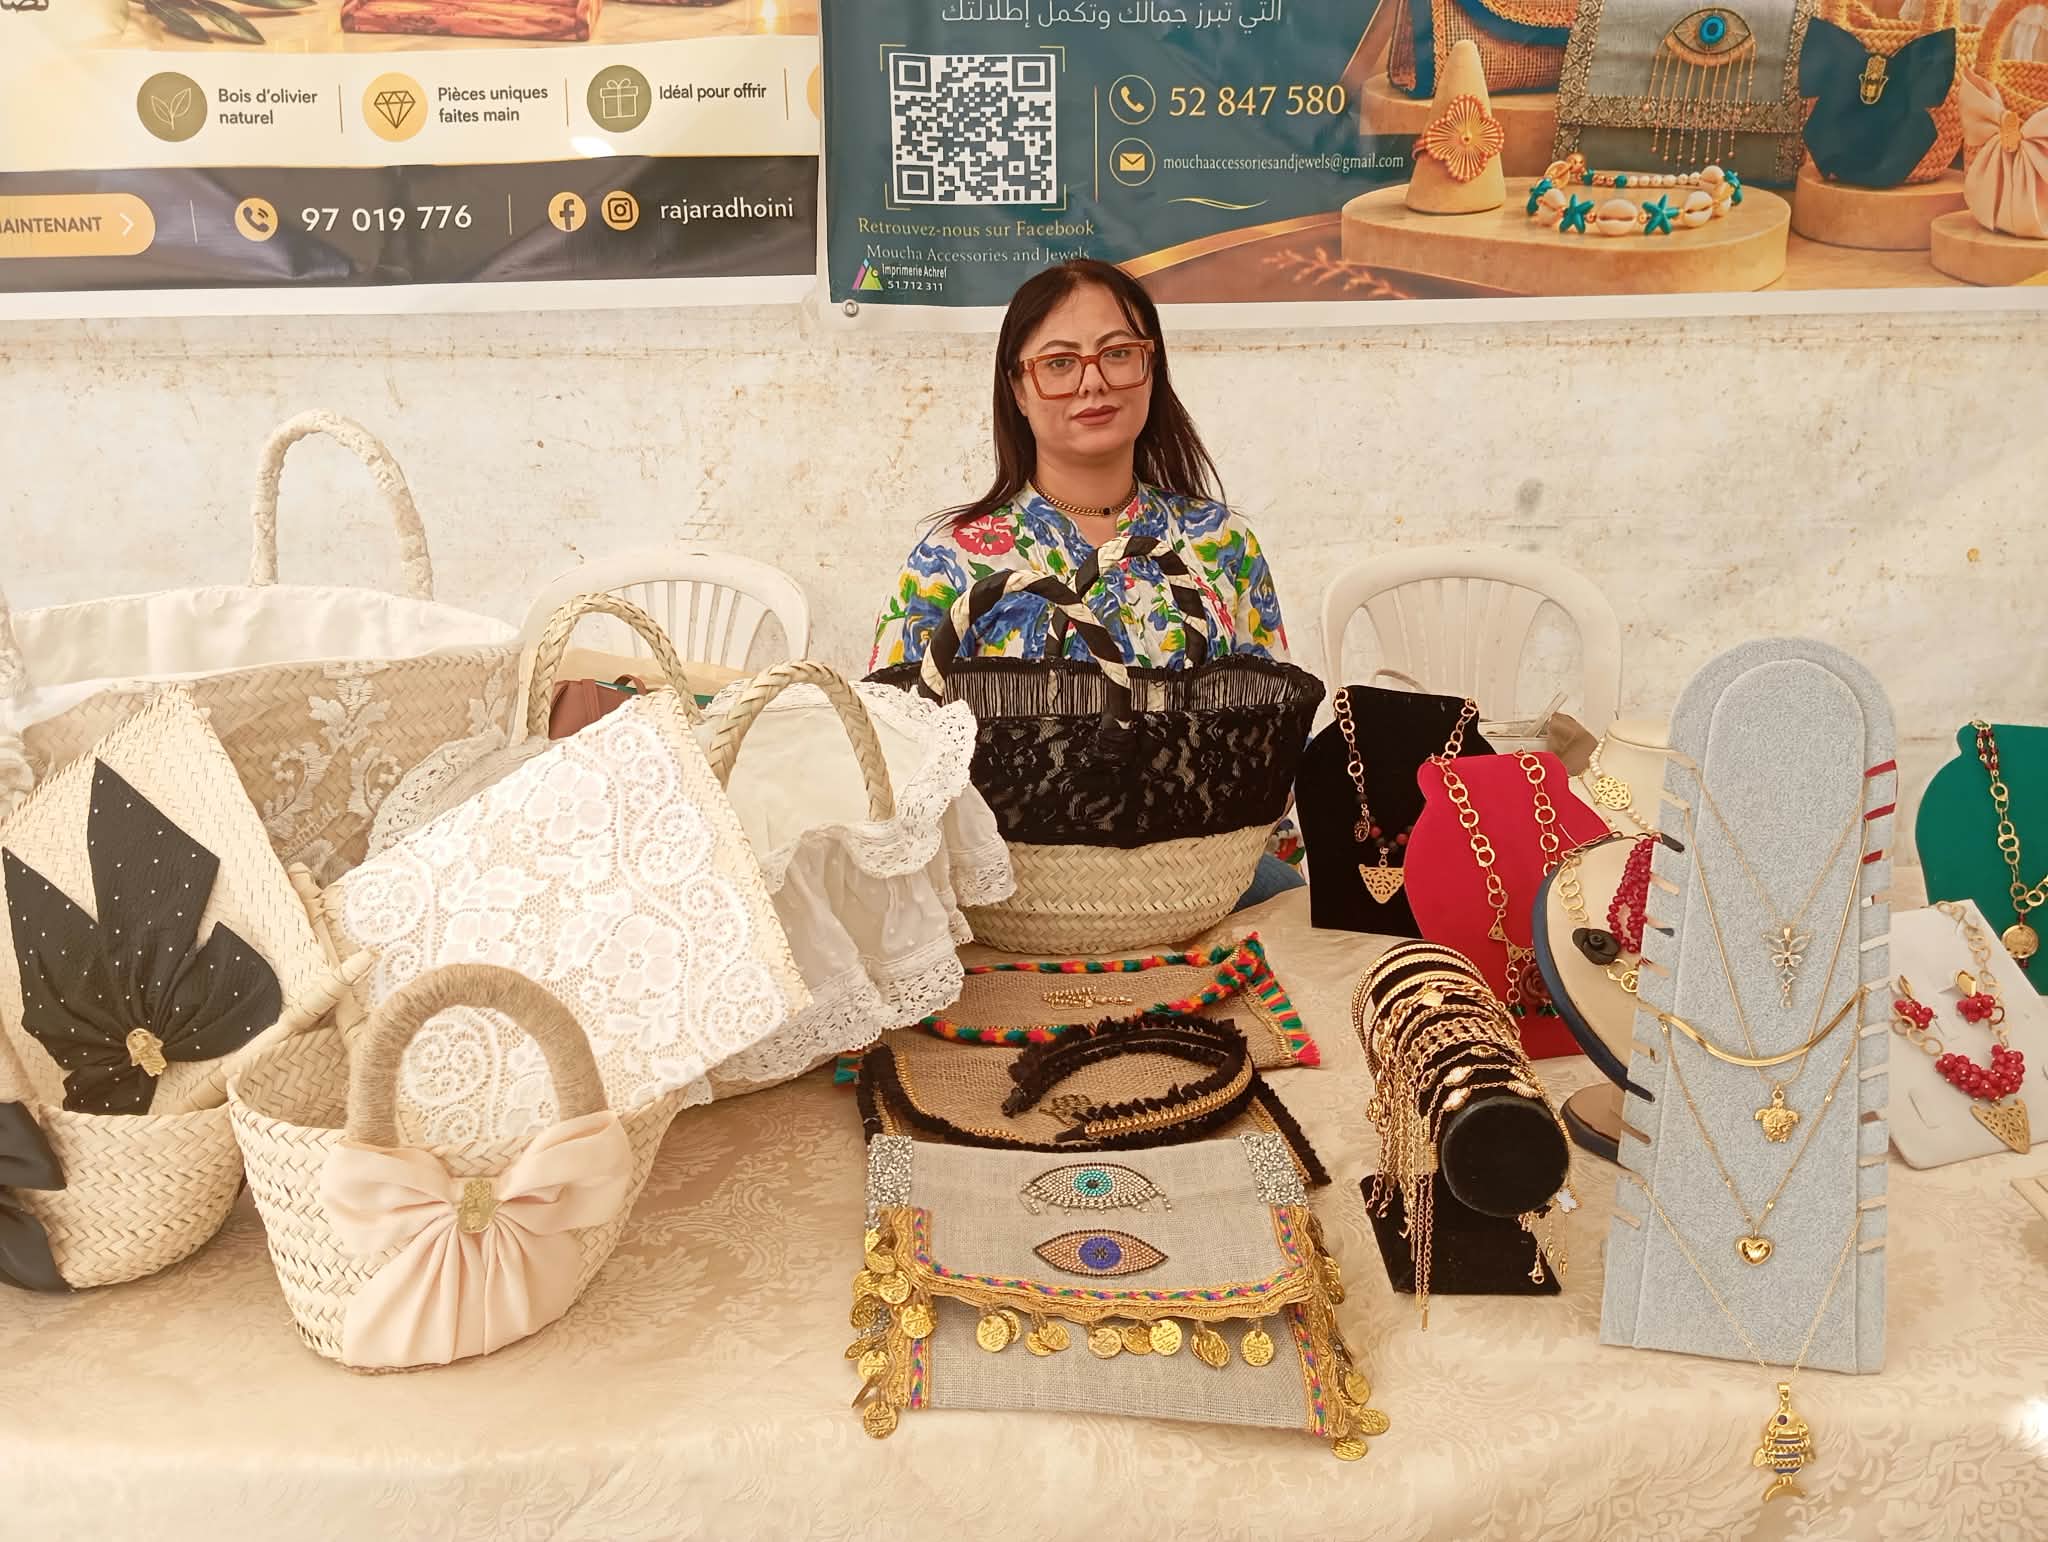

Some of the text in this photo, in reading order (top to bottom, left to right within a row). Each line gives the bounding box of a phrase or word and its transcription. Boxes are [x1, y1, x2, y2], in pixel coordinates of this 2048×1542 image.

[942, 0, 1282, 34] التي تبرز جمالك وتكمل إطلالتك
[218, 88, 318, 104] Bois d'olivier
[438, 86, 549, 103] Pièces uniques
[659, 84, 767, 102] Idéal pour offrir
[1169, 85, 1346, 117] 52 847 580
[219, 110, 274, 126] naturel
[439, 108, 520, 123] faites main
[1163, 152, 1404, 174] mouchaaccessoriesandjewels@gmail.com
[301, 204, 473, 232] 97 019 776
[660, 197, 794, 224] rajaradhoini
[0, 216, 102, 234] AINTENANT
[858, 217, 1095, 237] Retrouvez-nous sur Facebook
[866, 244, 1090, 264] Moucha Accessories and Jewels
[881, 263, 948, 279] Imprimerie Achref
[887, 280, 943, 292] 51 712 311
